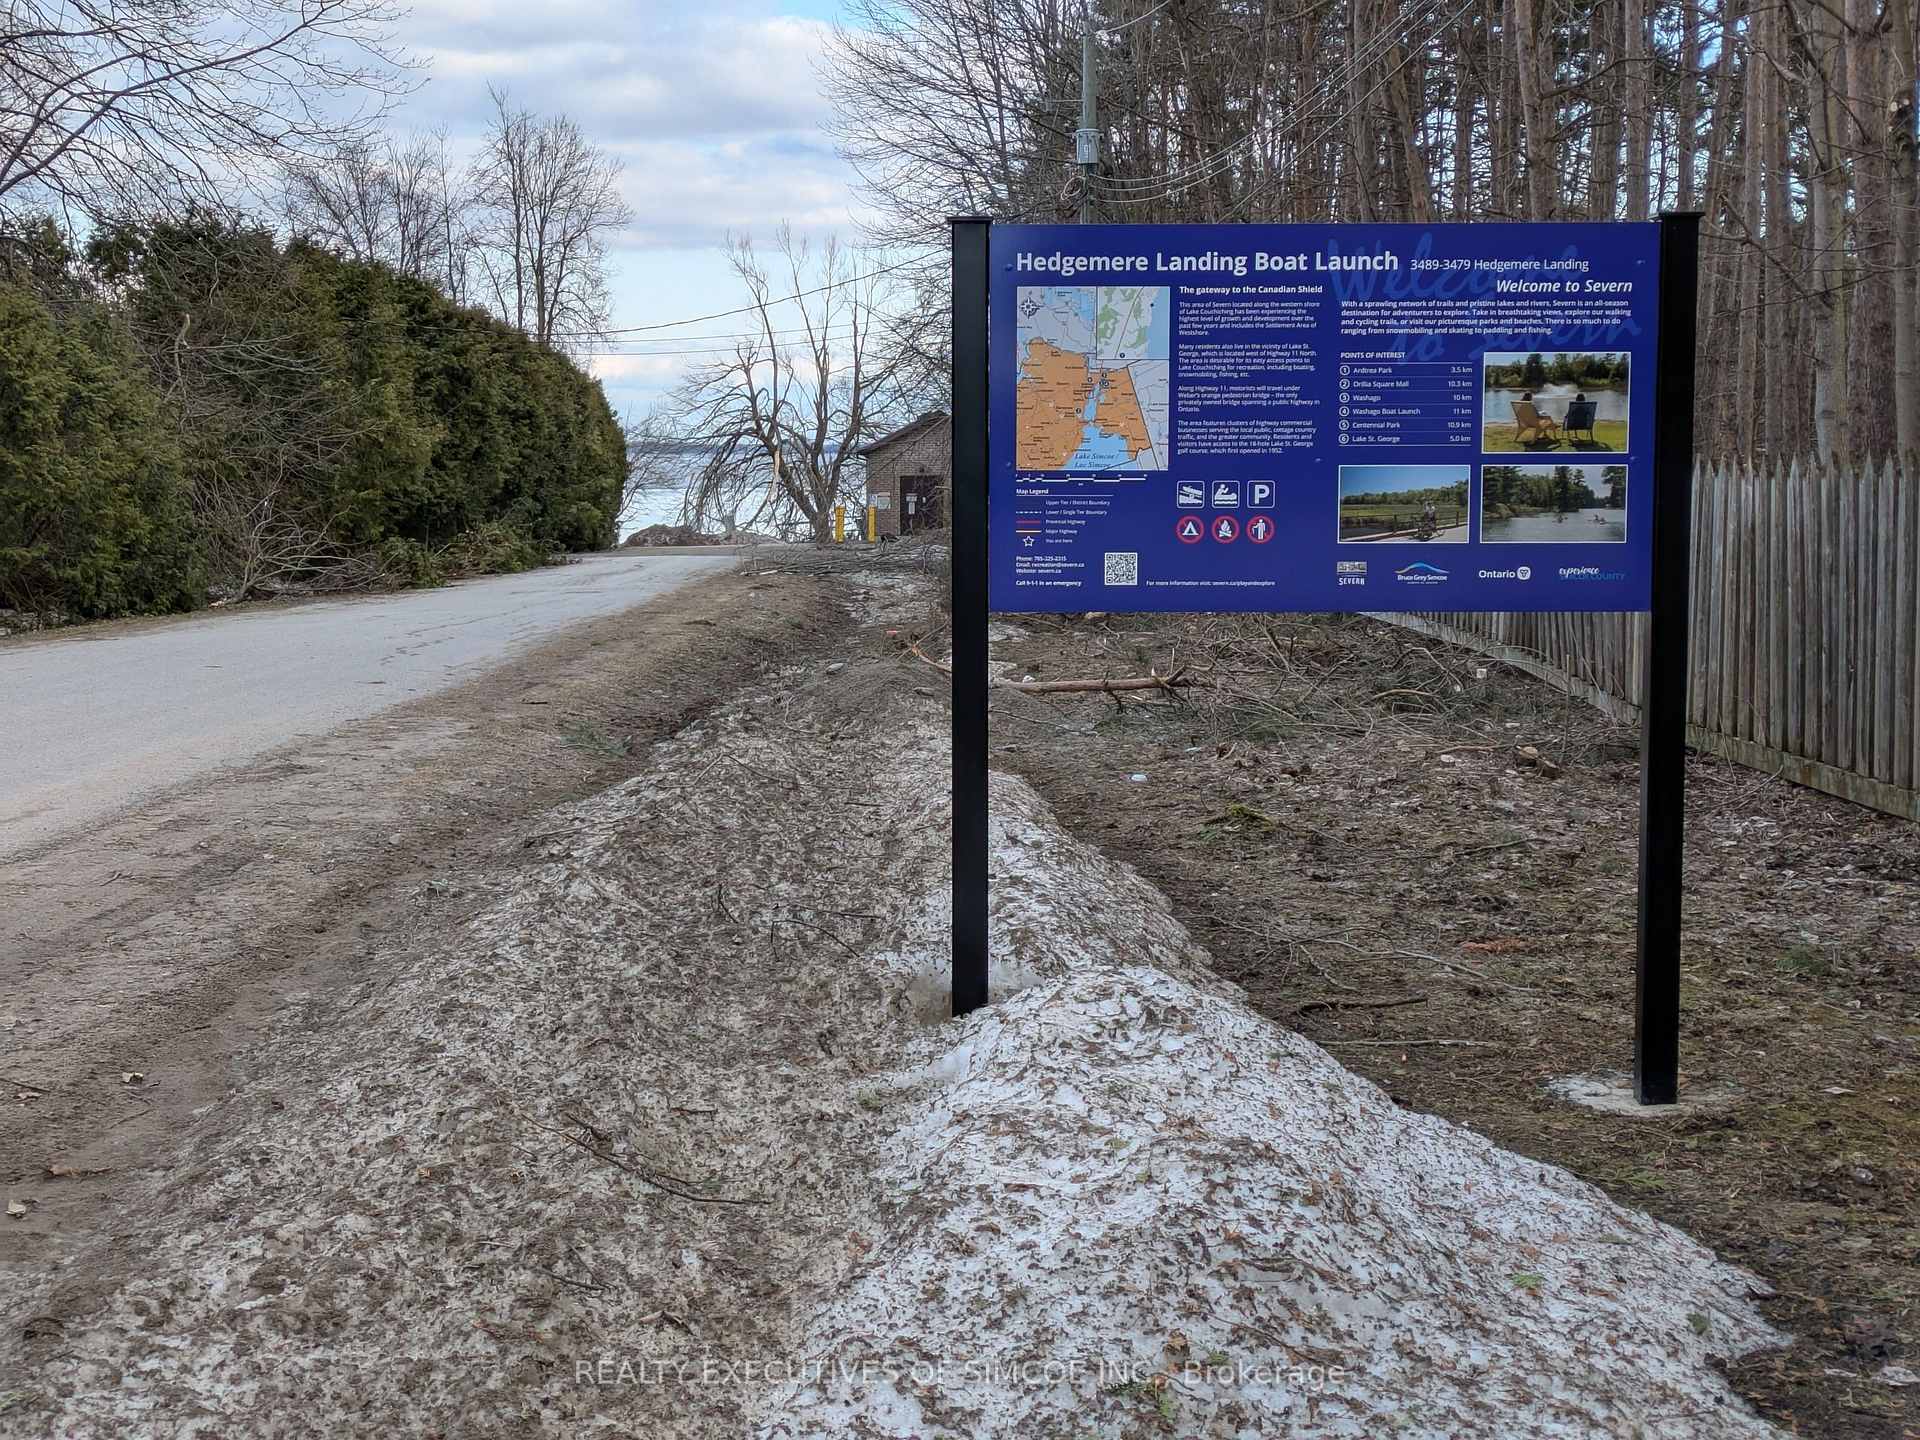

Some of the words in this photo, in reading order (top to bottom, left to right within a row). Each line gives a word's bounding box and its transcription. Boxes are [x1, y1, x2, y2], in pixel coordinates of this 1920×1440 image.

[1016, 252, 1150, 276] Hedgemere
[1155, 251, 1248, 276] Landing
[1253, 252, 1308, 270] Boat
[1313, 251, 1398, 270] Launch
[1410, 259, 1471, 269] 3489-3479
[1473, 259, 1541, 272] Hedgemere
[1543, 259, 1589, 272] Landing
[1496, 279, 1561, 292] Welcome
[1564, 281, 1581, 292] to
[1583, 280, 1633, 292] Severn
[1196, 287, 1231, 295] gateway
[1364, 300, 1397, 308] sprawling
[1469, 300, 1496, 308] pristine
[1443, 309, 1471, 317] explore.
[1497, 309, 1542, 317] breathtaking
[1564, 309, 1591, 317] explore
[1604, 309, 1632, 317] walking
[1355, 319, 1379, 327] cycling
[1379, 318, 1399, 326] trails,
[1437, 318, 1478, 326] picturesque
[1479, 318, 1499, 326] parks
[1341, 327, 1367, 335] ranging
[1385, 327, 1433, 335] snowmobiling
[1448, 327, 1474, 335] skating
[1483, 327, 1513, 335] paddling
[1528, 327, 1553, 335] fishing.
[1372, 381, 1395, 389] Square
[1376, 435, 1400, 443] George
[1254, 484, 1270, 504] P
[1478, 569, 1516, 578] Ontario
